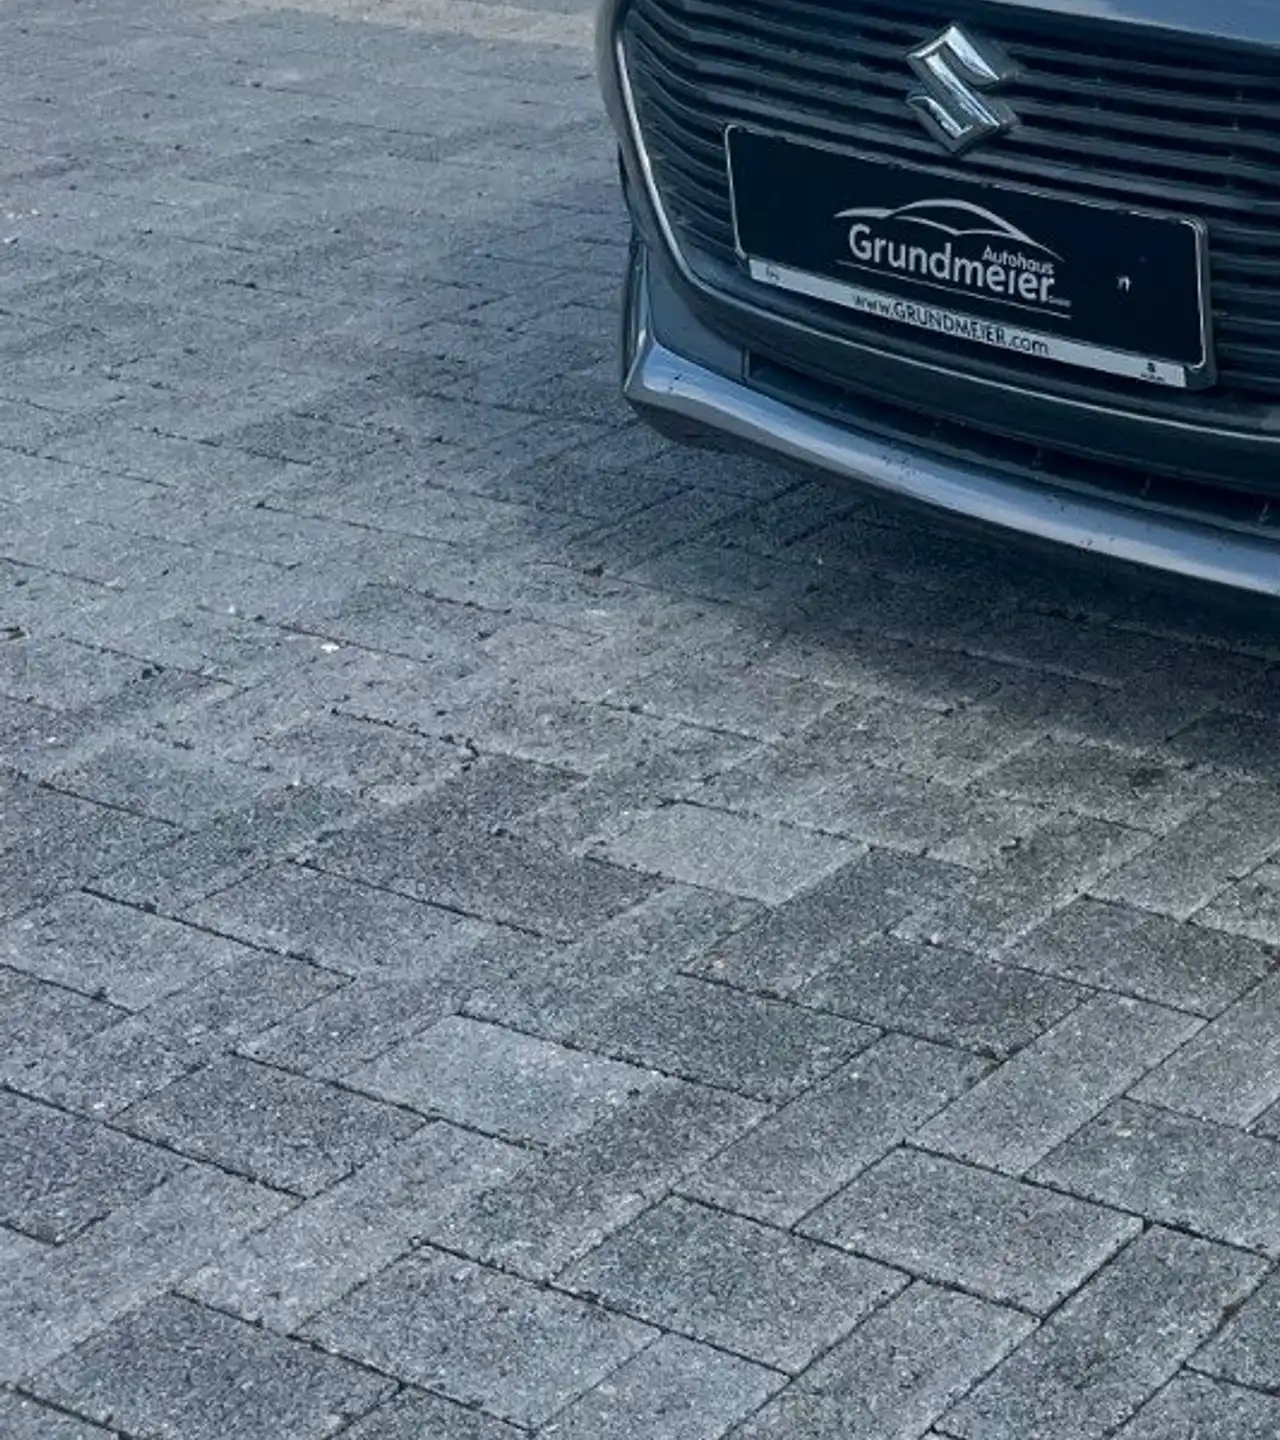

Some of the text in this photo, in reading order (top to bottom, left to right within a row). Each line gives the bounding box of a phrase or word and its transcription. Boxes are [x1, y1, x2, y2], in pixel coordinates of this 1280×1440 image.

[848, 223, 1056, 302] Grundmeier
[981, 244, 1055, 275] Autohaus
[852, 294, 1049, 356] www.GRUNDMEIER.com
